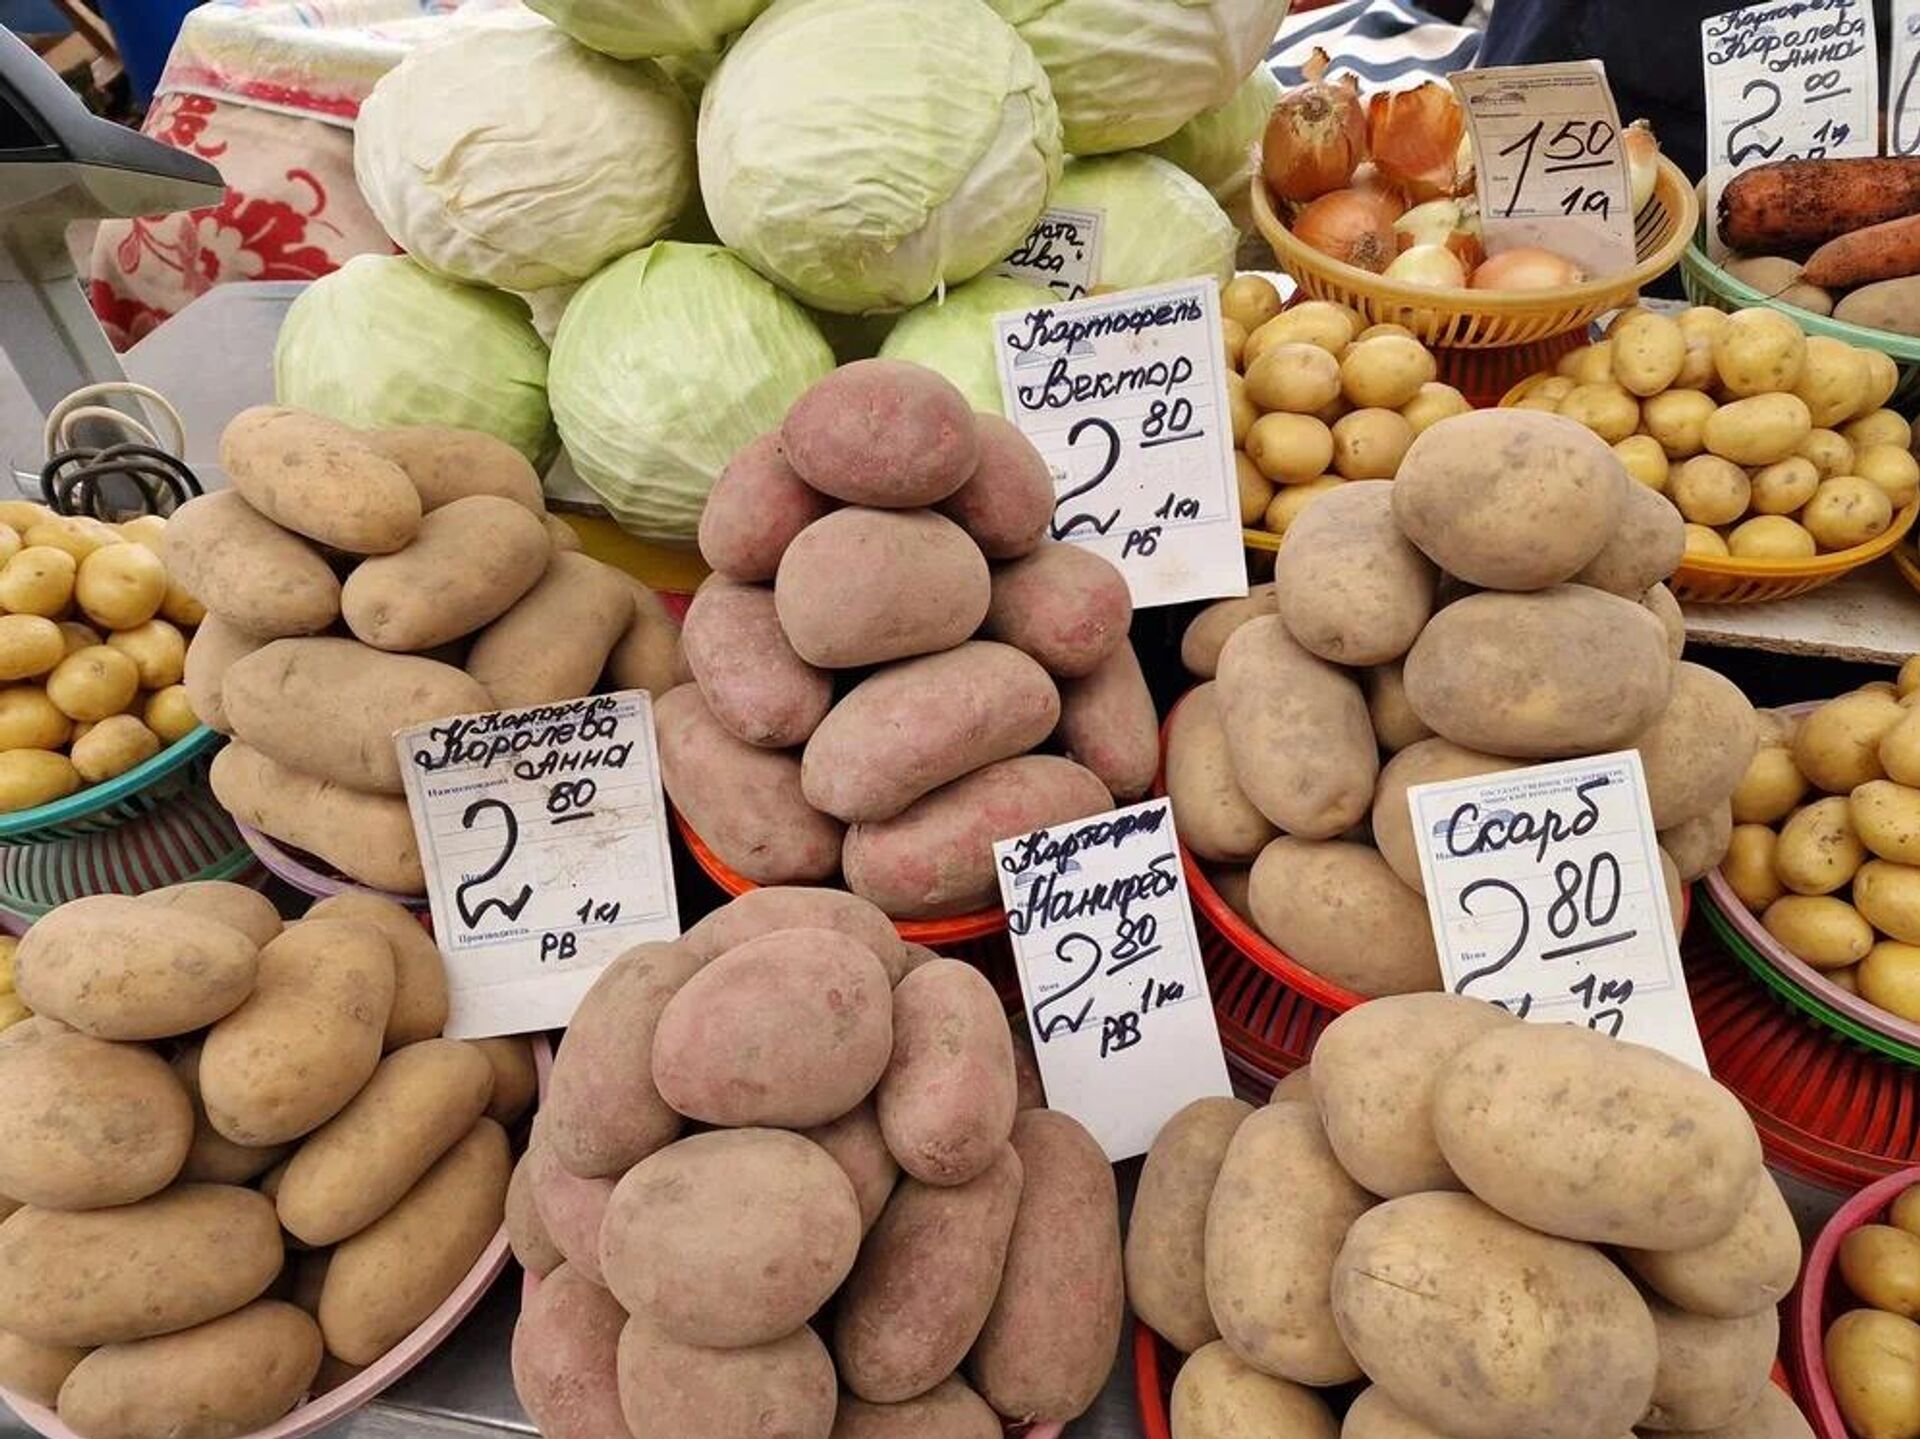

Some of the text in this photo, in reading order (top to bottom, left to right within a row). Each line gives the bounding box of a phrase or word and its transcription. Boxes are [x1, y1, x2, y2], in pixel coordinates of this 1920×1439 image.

[1728, 79, 1784, 167] 2
[1500, 120, 1614, 217] 1 50
[1007, 300, 1202, 353] Картофель
[1018, 356, 1192, 410] Вектор
[1052, 398, 1193, 541] 2 80
[414, 711, 618, 770] Королева
[514, 742, 634, 780] Анна
[456, 778, 597, 930] 2 80
[1446, 776, 1610, 863] Скарб
[1548, 852, 1621, 939] 80
[1032, 913, 1157, 1043] 2 80
